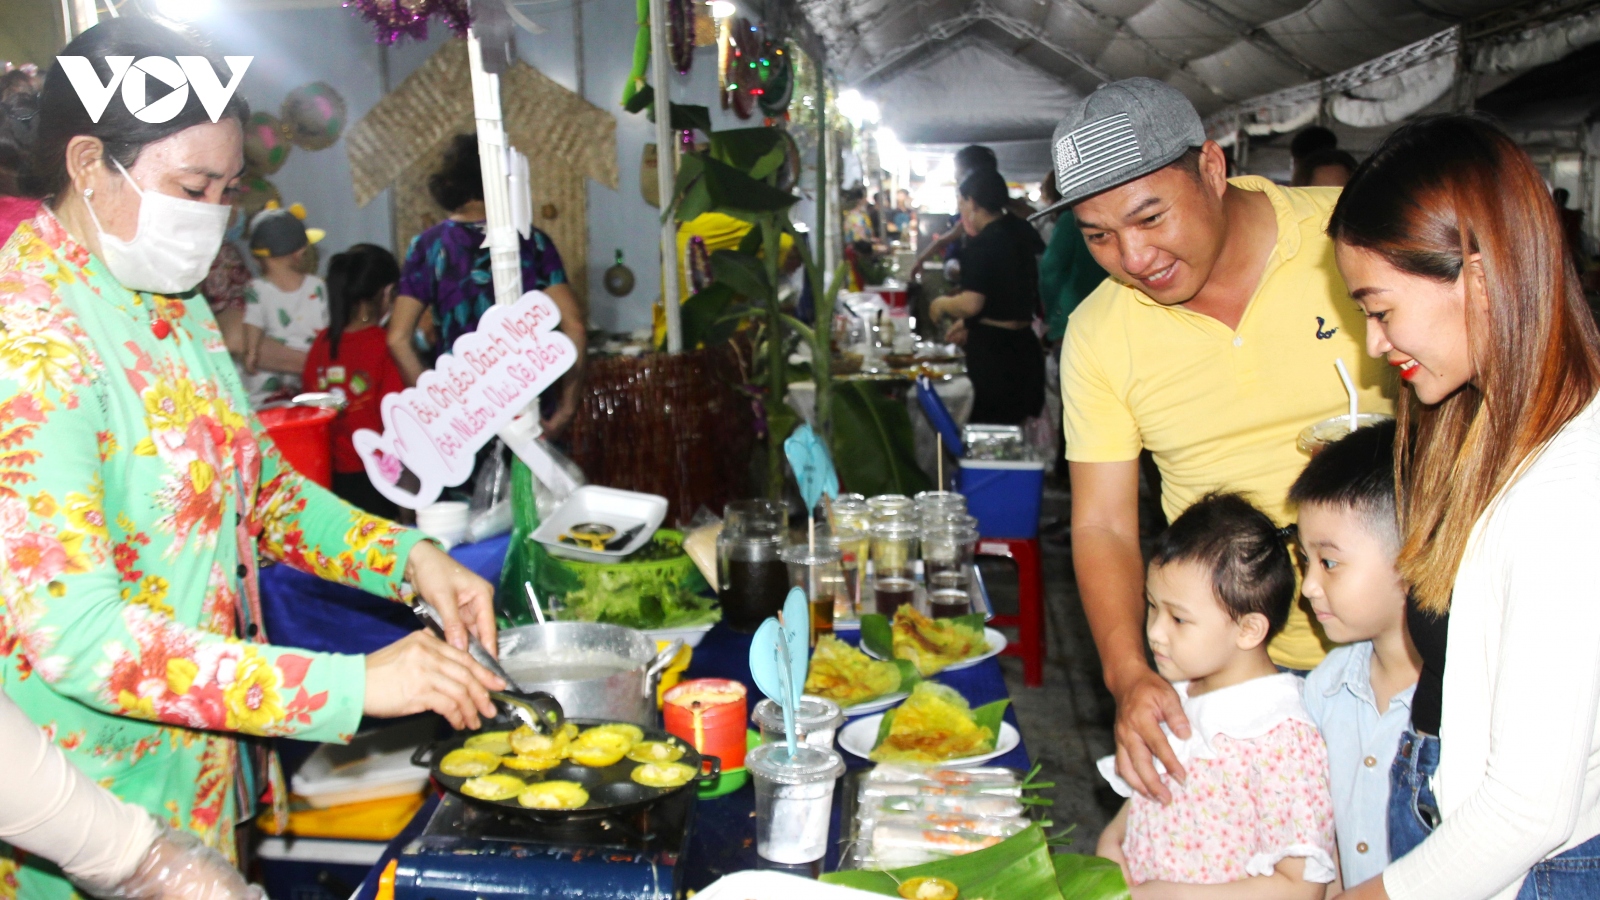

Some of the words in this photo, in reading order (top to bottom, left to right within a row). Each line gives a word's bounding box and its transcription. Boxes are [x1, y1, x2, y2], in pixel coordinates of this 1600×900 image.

[427, 367, 475, 408] Chiếc
[463, 333, 521, 375] Bánh
[501, 304, 550, 345] Ngon
[482, 381, 519, 408] Vui
[507, 363, 536, 388] Sẽ
[526, 344, 565, 371] Đến
